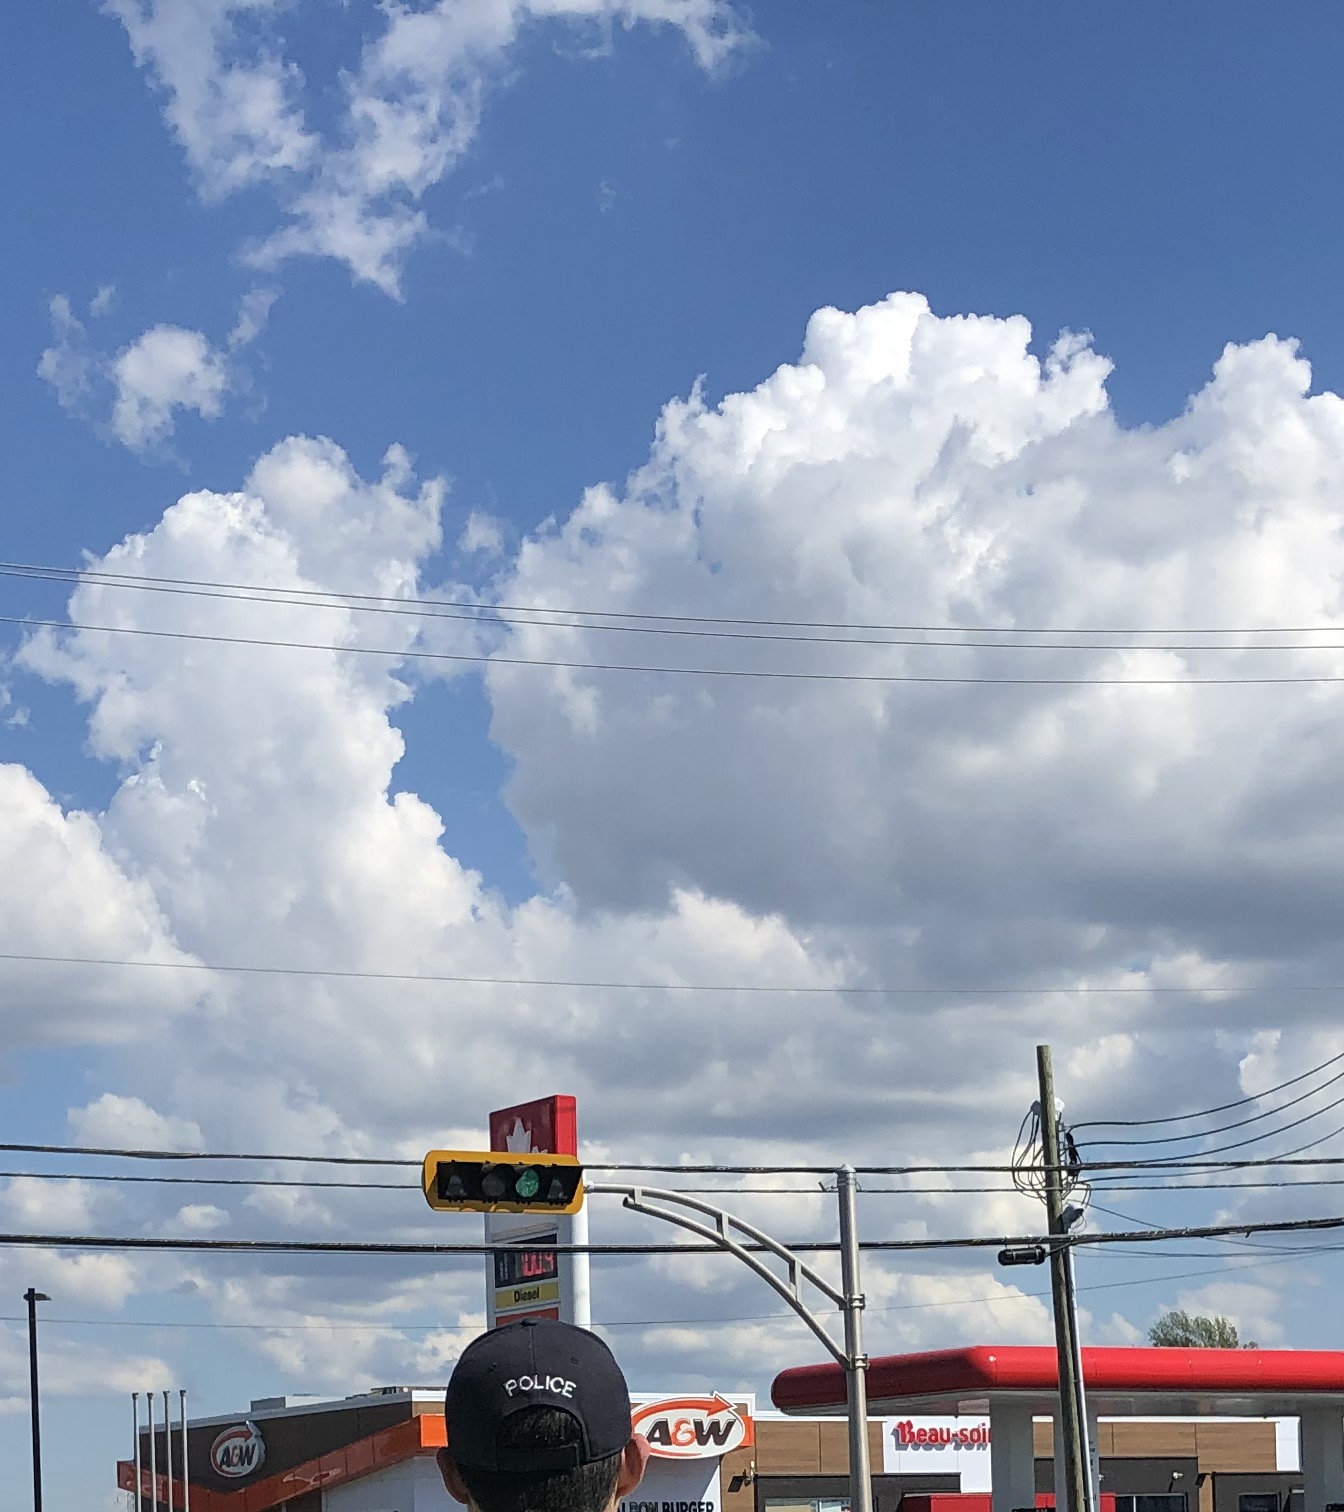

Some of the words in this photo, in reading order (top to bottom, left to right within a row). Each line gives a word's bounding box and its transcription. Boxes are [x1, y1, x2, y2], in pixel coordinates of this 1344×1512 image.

[513, 1287, 540, 1303] Diesel
[503, 1374, 577, 1399] POLICE
[646, 1417, 736, 1447] A&W
[220, 1443, 257, 1468] A&W
